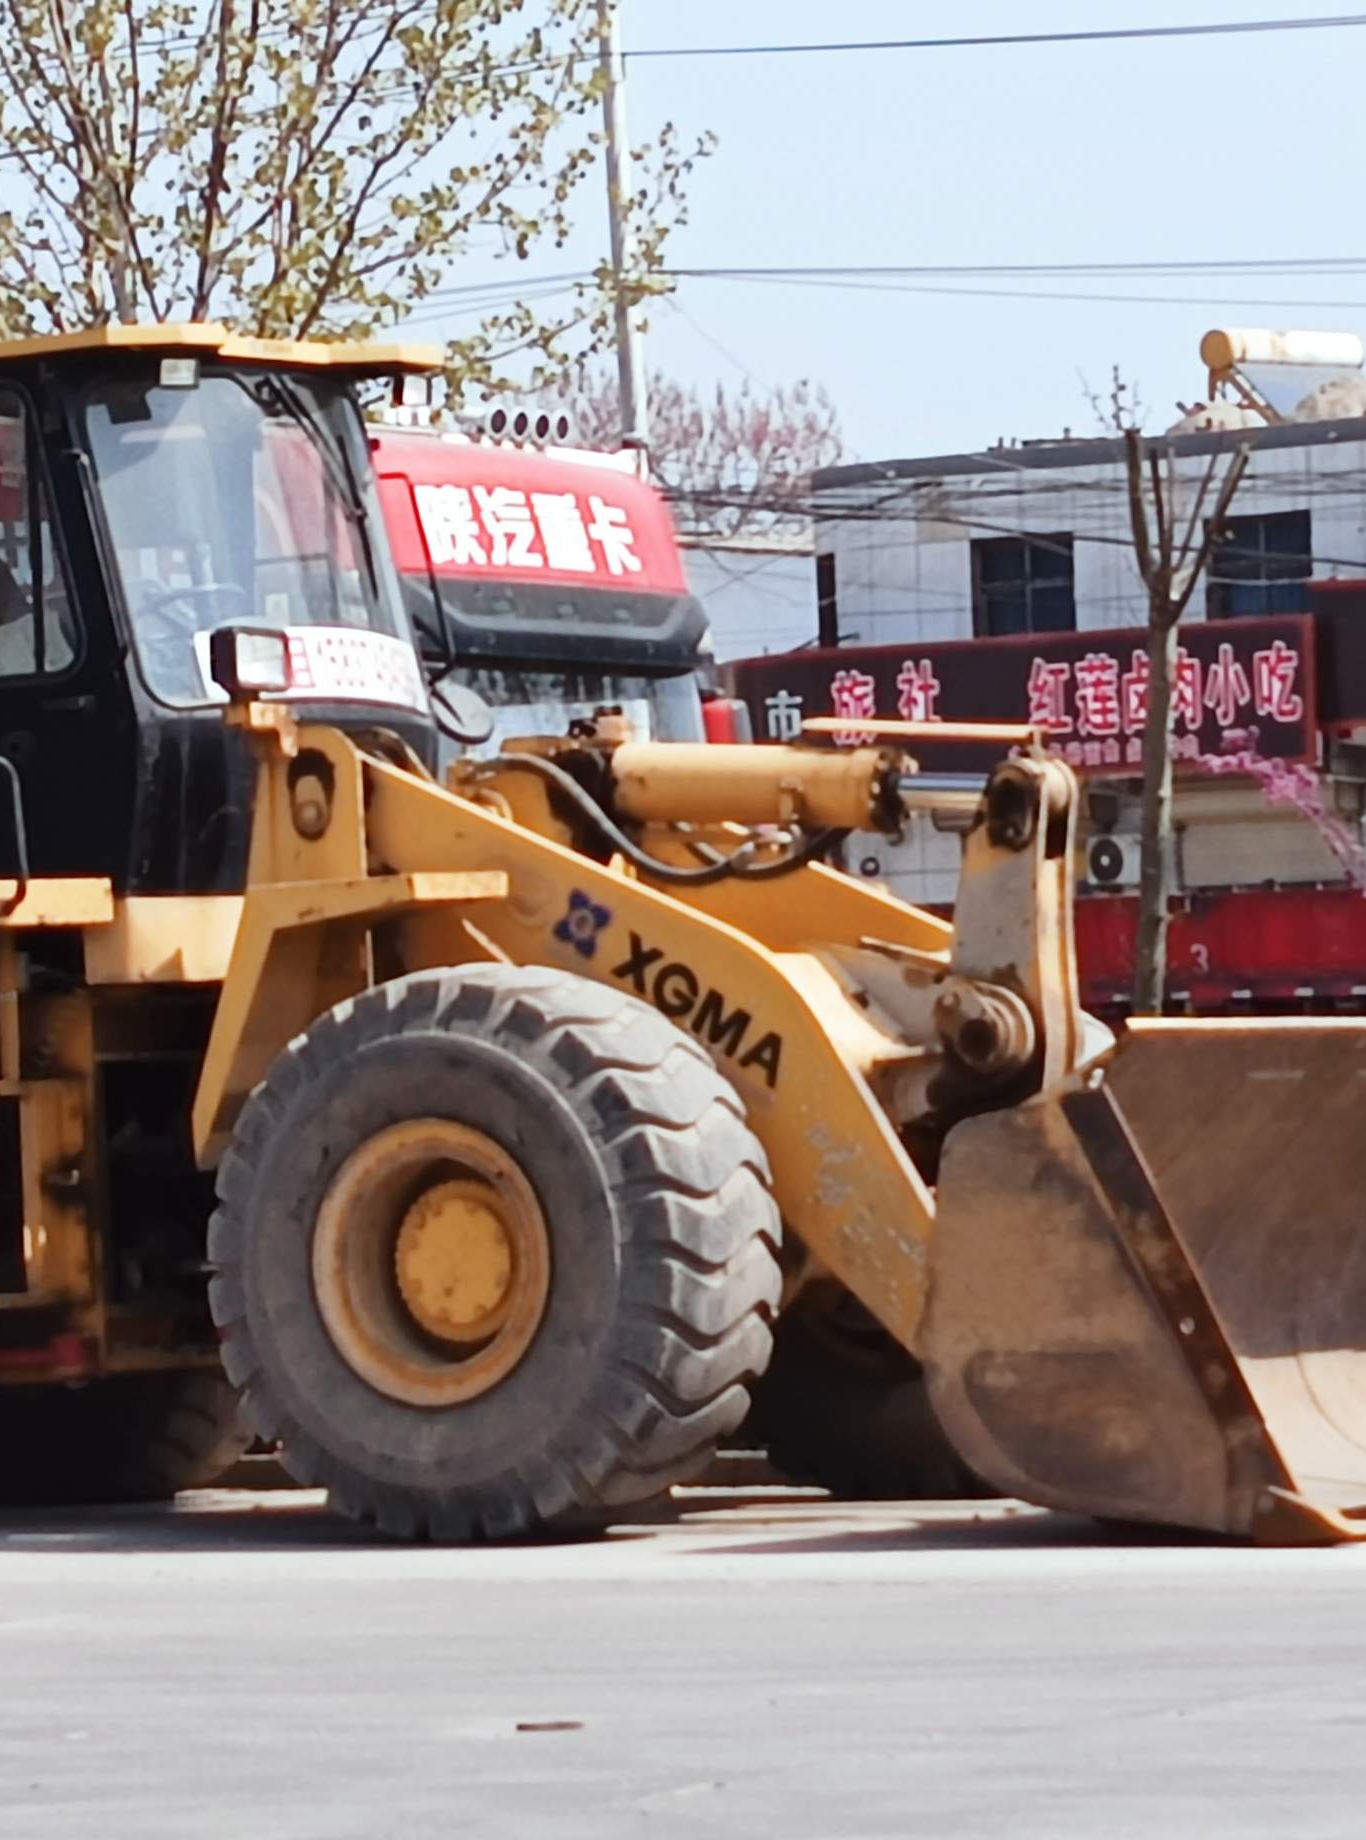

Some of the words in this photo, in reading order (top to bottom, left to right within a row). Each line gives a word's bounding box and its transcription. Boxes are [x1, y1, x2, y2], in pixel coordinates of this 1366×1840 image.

[414, 484, 643, 576] 陕汽重卡
[610, 931, 783, 1089] XGMA
